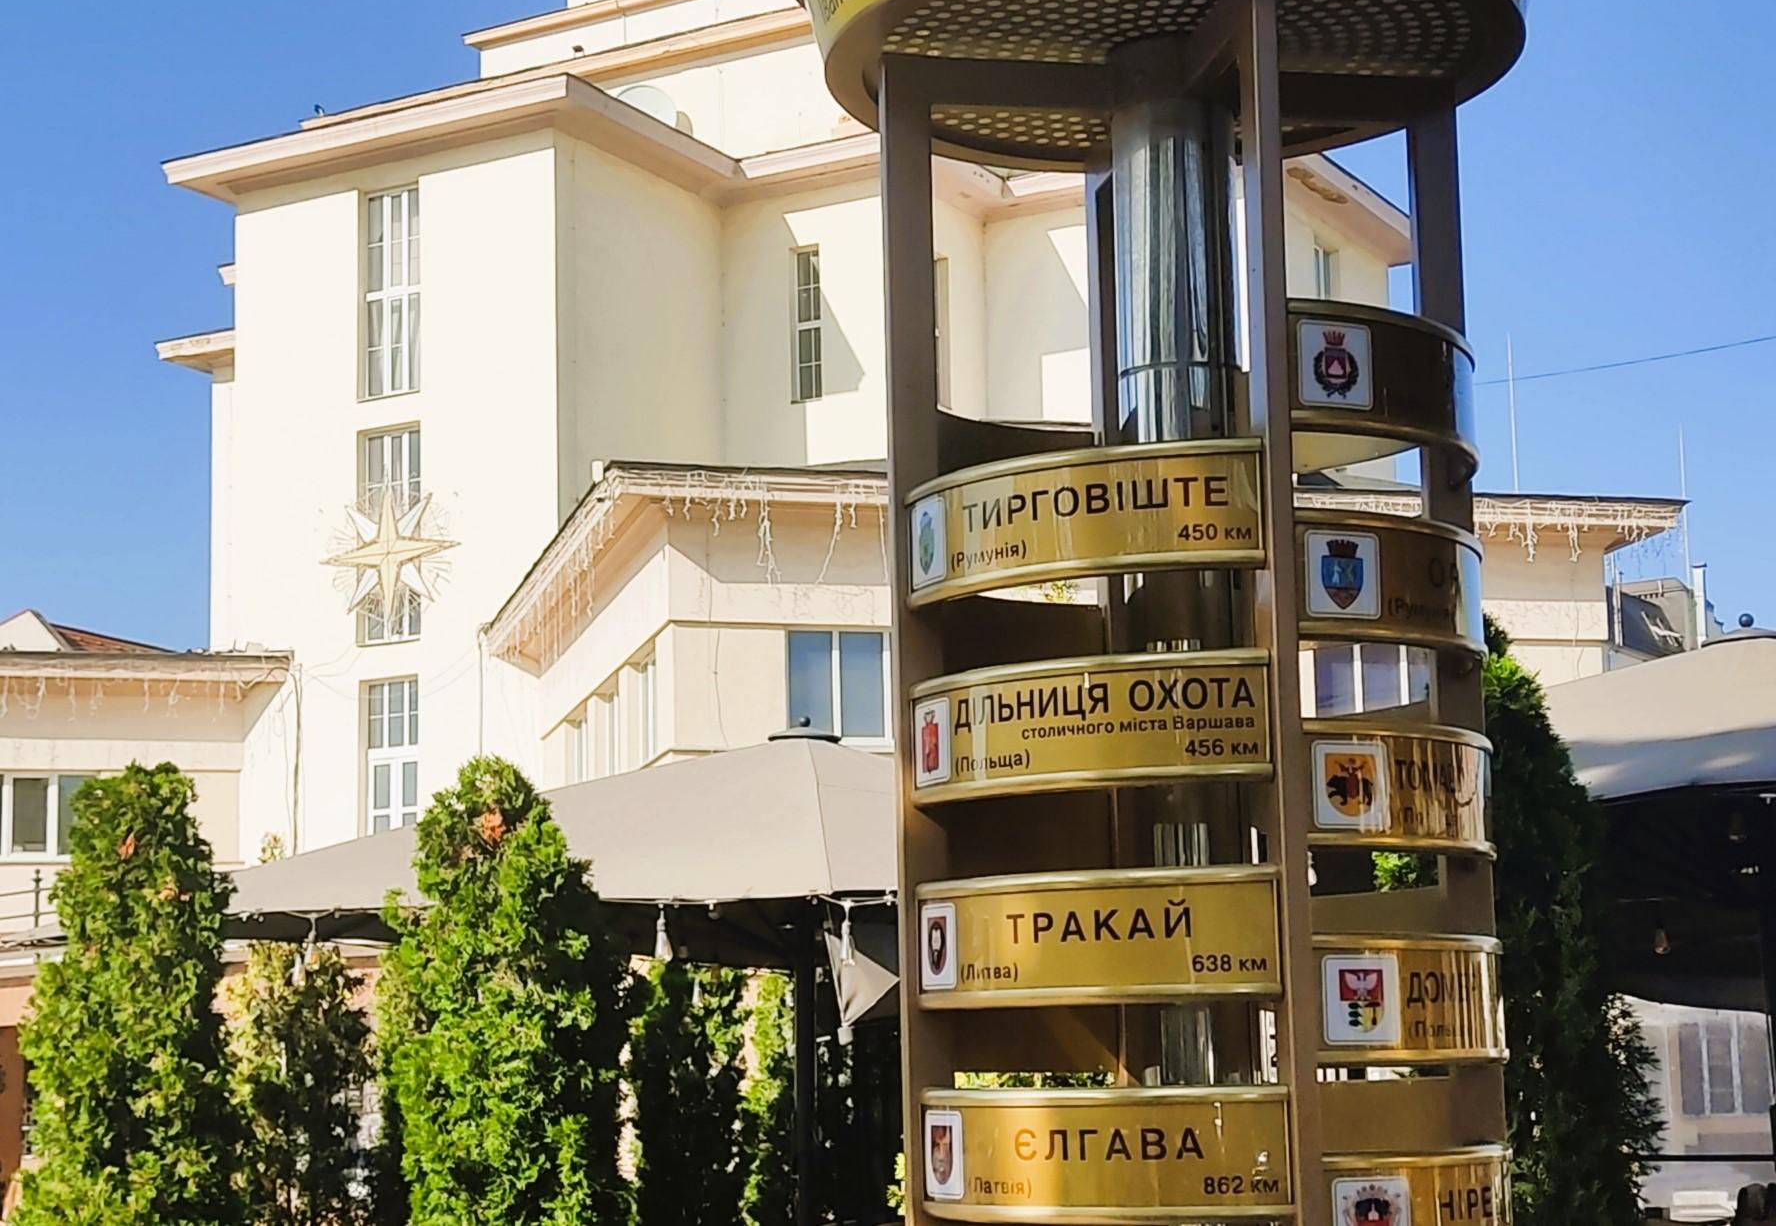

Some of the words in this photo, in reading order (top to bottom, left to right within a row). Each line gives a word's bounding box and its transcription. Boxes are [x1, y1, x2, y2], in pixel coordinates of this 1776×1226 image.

[962, 476, 1229, 533] ТИРГОВІШТЕ
[1178, 524, 1218, 541] 450
[1225, 527, 1252, 541] км
[951, 539, 1027, 572] (Румунія)
[954, 682, 1109, 735] ДІЛЬНИЦЯ
[1128, 677, 1256, 712] ОХОТА
[1021, 720, 1115, 741] столичного
[1119, 715, 1168, 732] міста
[1172, 714, 1256, 732] Варшава
[1185, 739, 1225, 756] 456
[1231, 742, 1259, 756] км
[955, 748, 1030, 775] (Польща)
[1006, 898, 1192, 945] ТРАКАЙ
[1192, 954, 1233, 973] 638
[1238, 958, 1267, 972] км
[1014, 1126, 1205, 1162] ЄЛГАВА
[968, 1176, 1032, 1199] (Латвія)
[1203, 1176, 1245, 1195] 862
[1250, 1179, 1279, 1194] км
